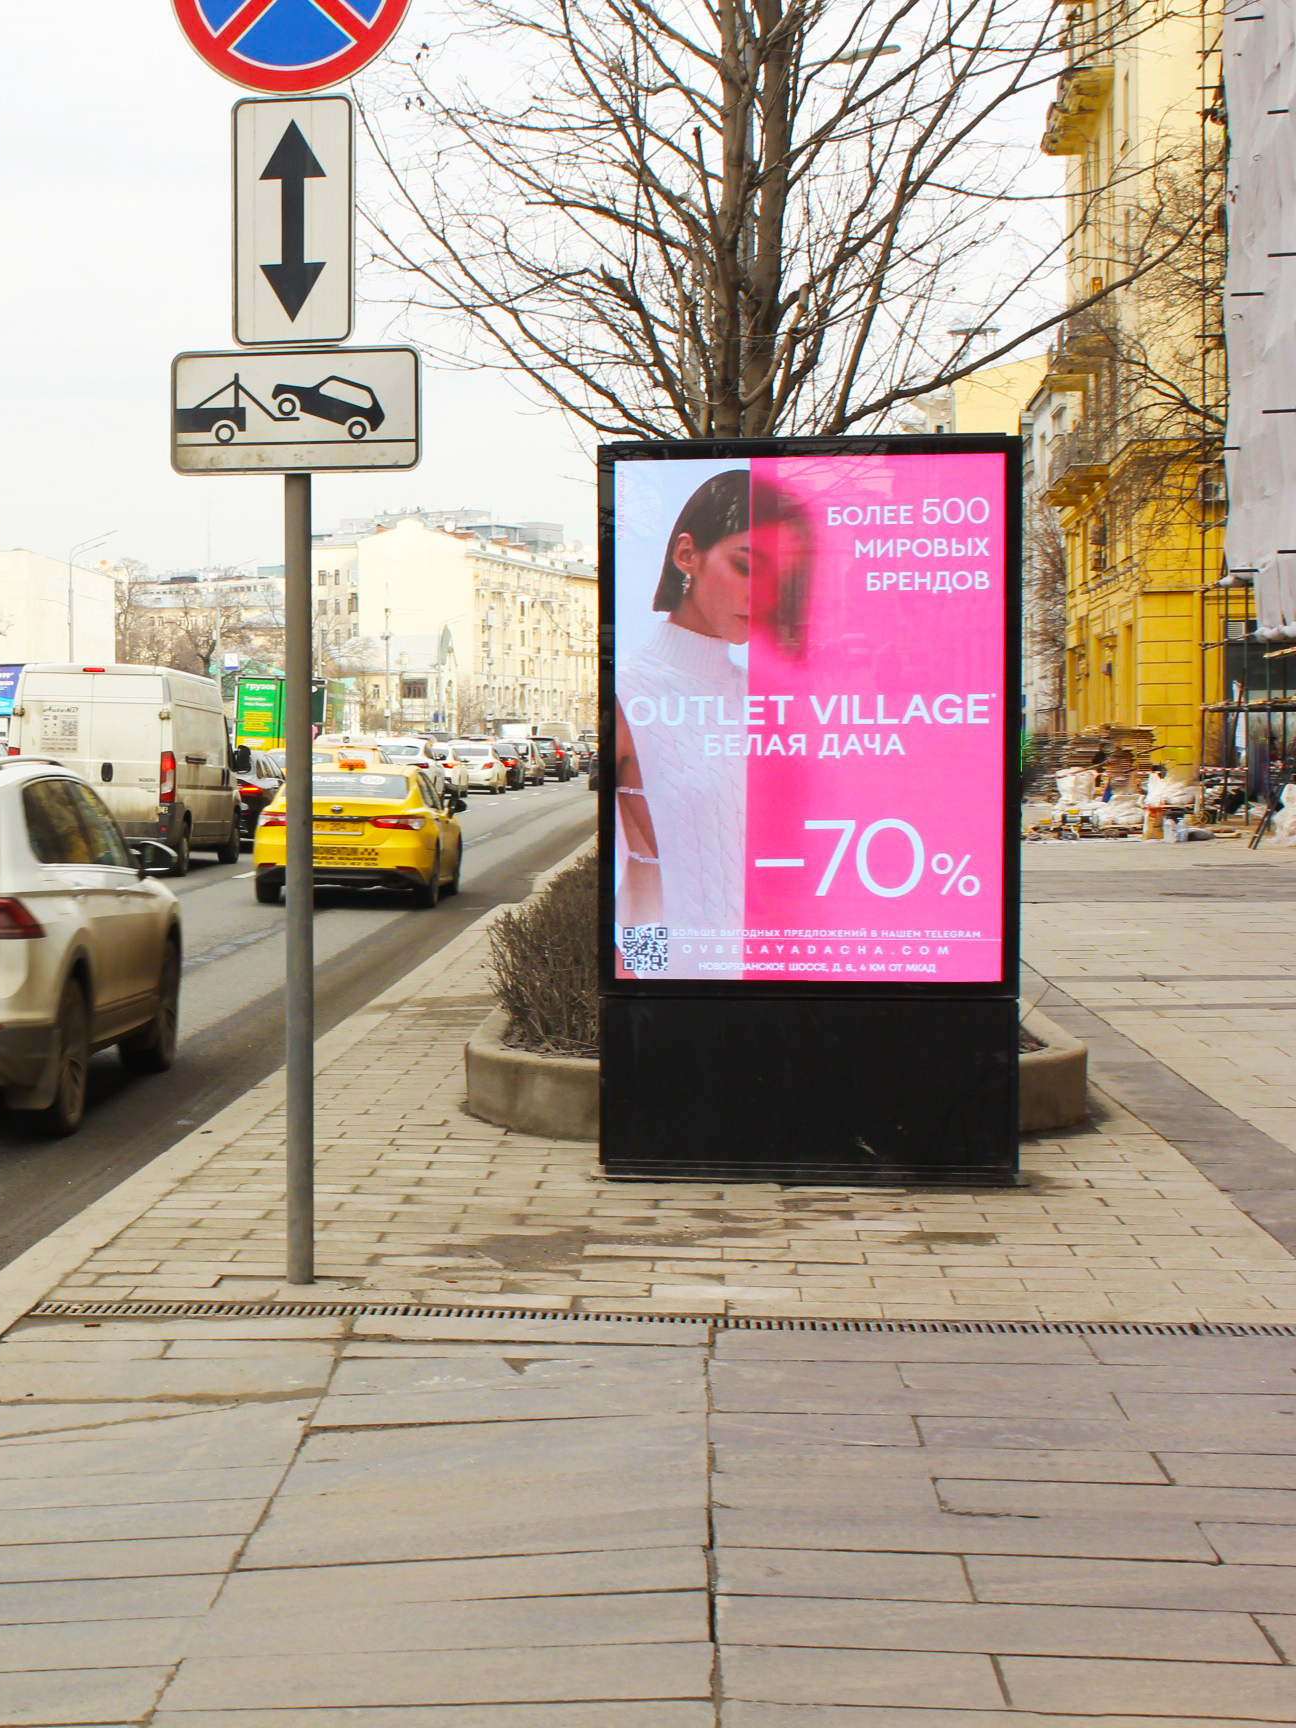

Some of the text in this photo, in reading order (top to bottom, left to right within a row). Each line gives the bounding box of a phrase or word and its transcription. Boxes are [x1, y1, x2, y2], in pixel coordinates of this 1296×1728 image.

[827, 497, 990, 526] БОЛЕЕ 500
[855, 538, 990, 559] МИРОВЫХ
[866, 571, 990, 594] БРЕНДОВ
[626, 695, 794, 726] OUTLET
[704, 733, 905, 760] БЕЛАЯ ДАЧА
[672, 928, 981, 938] БОЛЬШЕ ВЫГОДНЫХ ПРЕДЛОЖЕНИЙ В НАШЕМ TELEGRAM
[698, 962, 786, 971] НОВОРЯЗАНСКОЕ
[869, 964, 885, 972] КМ
[889, 964, 903, 972] ОТ
[906, 964, 937, 973] МКАД
